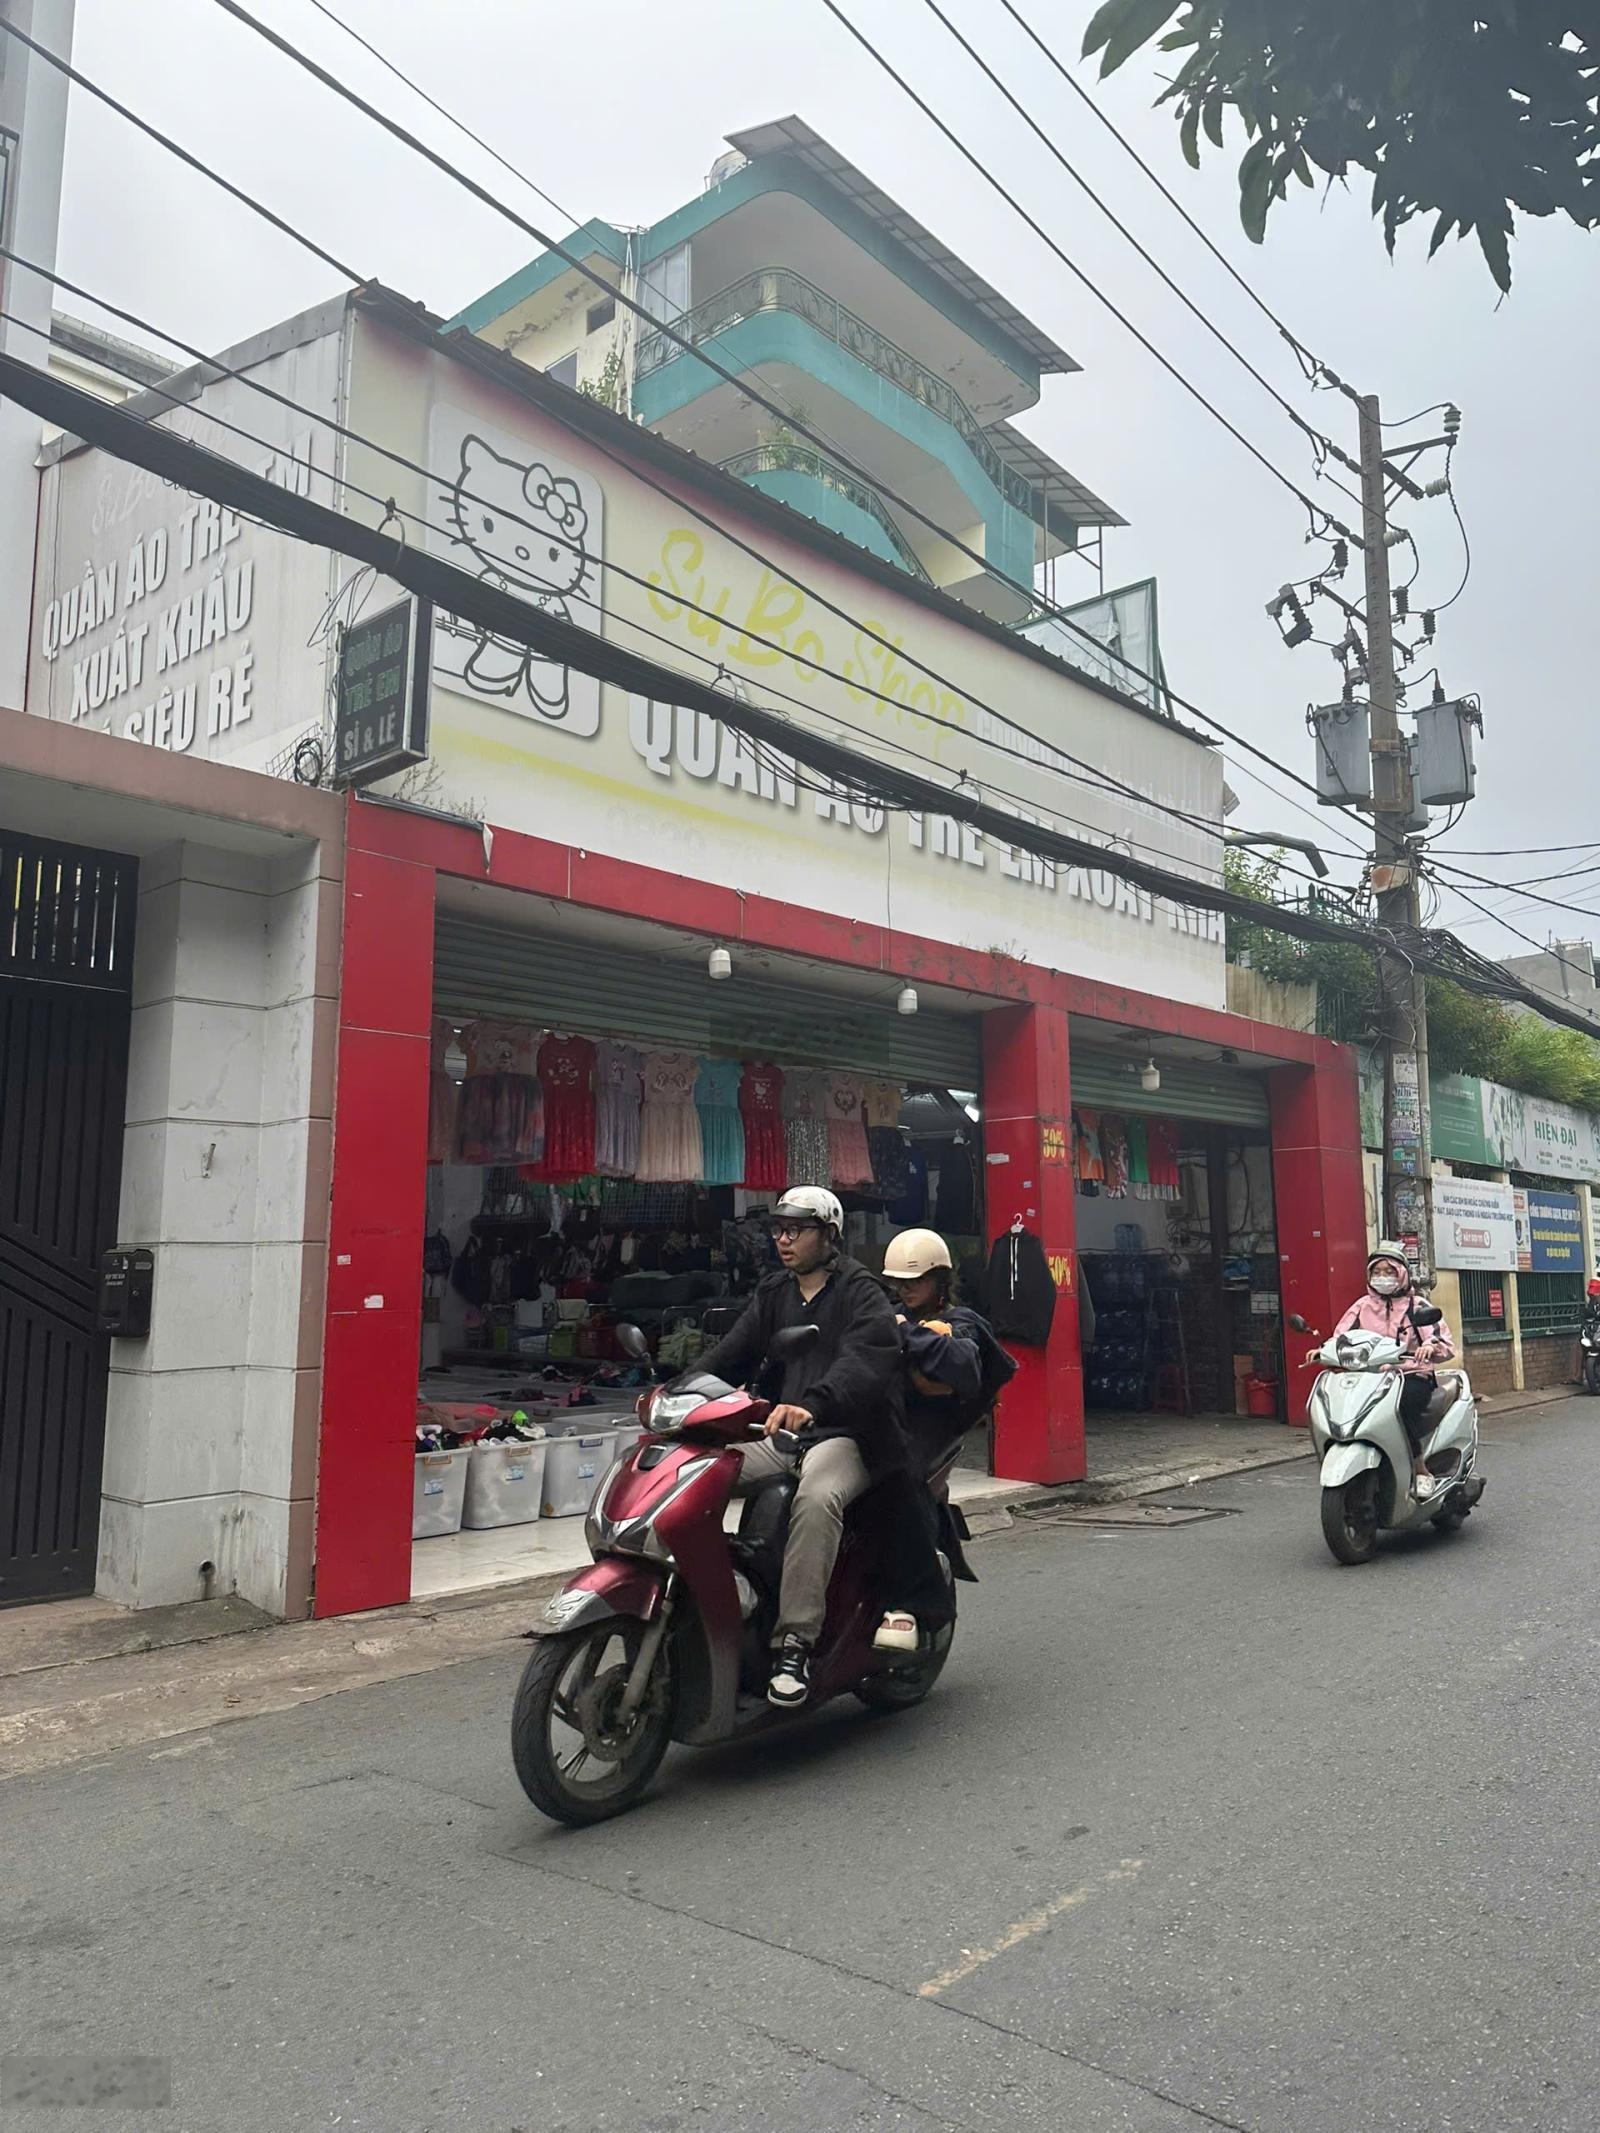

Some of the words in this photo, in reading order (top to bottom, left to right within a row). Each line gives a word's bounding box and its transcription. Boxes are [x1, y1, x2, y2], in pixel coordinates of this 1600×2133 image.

[43, 561, 117, 661] QUẦN
[127, 529, 168, 609] ÁO
[71, 617, 149, 720] XUẤT
[157, 553, 254, 672] KHẨU
[208, 640, 253, 736] RẺ
[345, 672, 372, 715] TRẺ
[376, 665, 401, 702] EM
[363, 728, 374, 753] &
[379, 705, 396, 746] LẺ
[843, 620, 965, 757] Shop
[1534, 1118, 1559, 1145] HIỆN
[1561, 1129, 1577, 1149] ĐẠI
